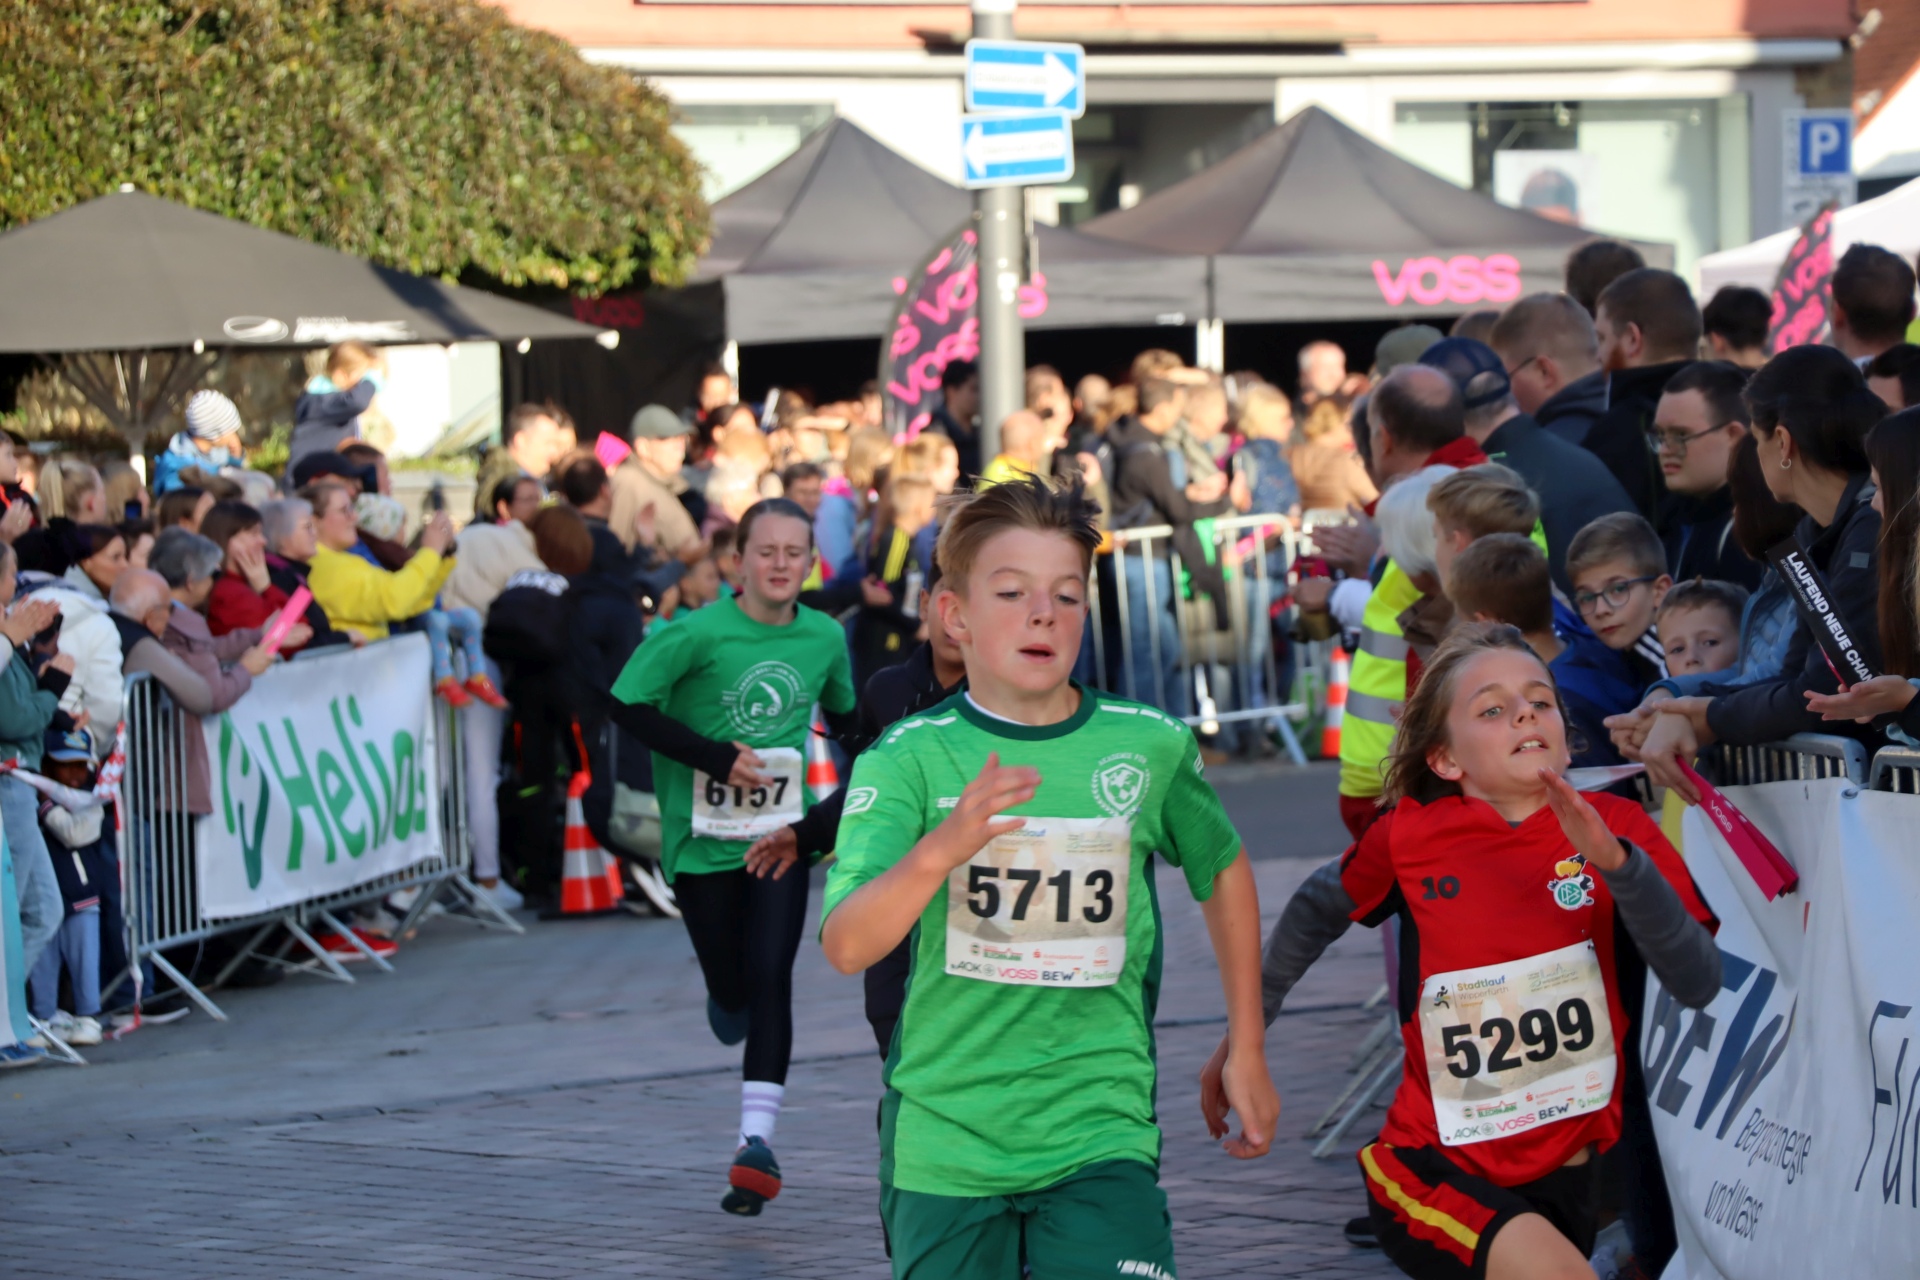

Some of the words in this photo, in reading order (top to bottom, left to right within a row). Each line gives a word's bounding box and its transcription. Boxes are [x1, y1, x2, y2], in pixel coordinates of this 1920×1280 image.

[1371, 253, 1523, 306] VOSS
[1786, 551, 1830, 613] LAUFEND
[1823, 612, 1853, 651] NEUE
[705, 776, 789, 808] 6157
[1710, 799, 1733, 833] VOSS
[967, 864, 1114, 924] 5713
[1421, 875, 1461, 900] 10
[957, 960, 983, 974] AOK
[997, 966, 1039, 981] VOSS
[1042, 970, 1075, 982] BEW
[1457, 974, 1506, 992] Stadtlauf
[1458, 985, 1509, 1001] Wipperfürth
[1441, 997, 1595, 1079] 5299
[1453, 1125, 1482, 1140] AOK
[1495, 1113, 1537, 1132] VOSS
[1538, 1103, 1570, 1121] BEW
